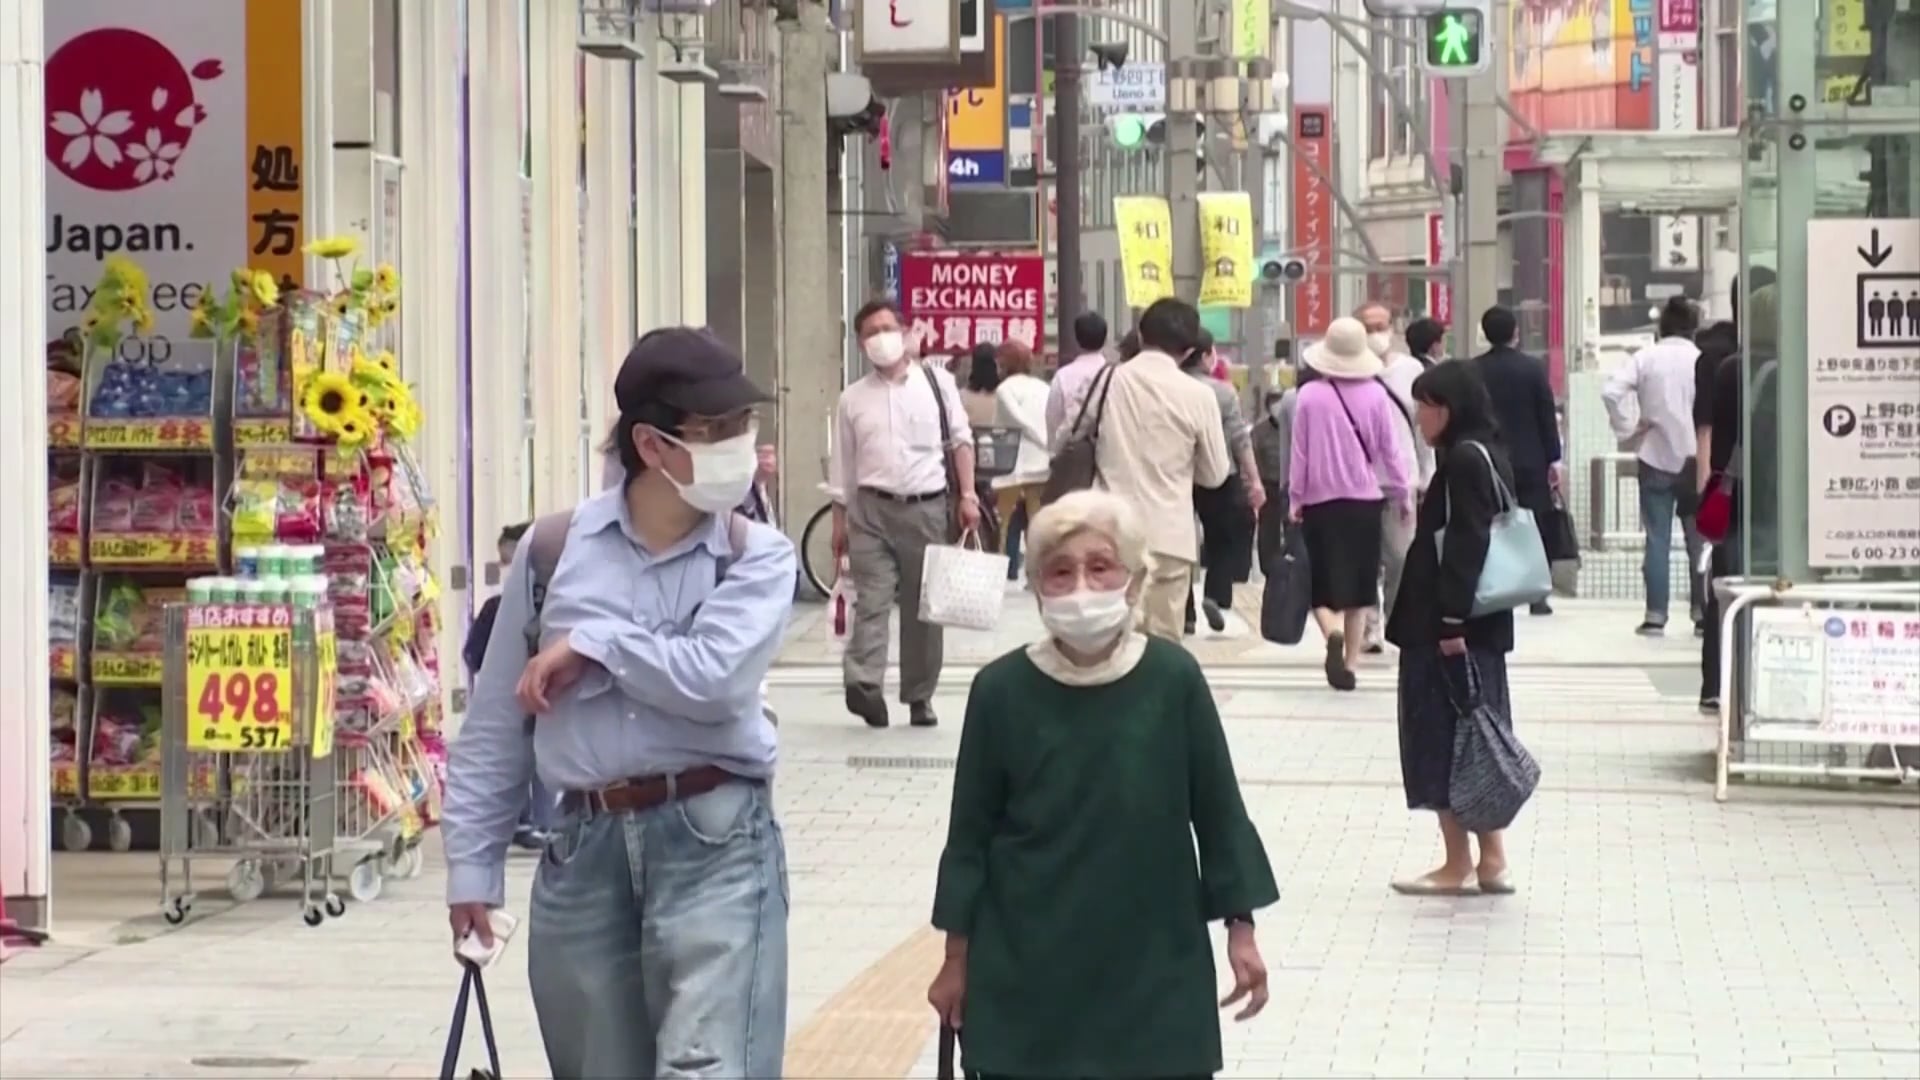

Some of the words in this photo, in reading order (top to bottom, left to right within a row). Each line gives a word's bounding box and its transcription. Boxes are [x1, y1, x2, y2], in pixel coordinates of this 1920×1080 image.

[1112, 88, 1144, 99] Ueno
[1149, 88, 1157, 98] 4
[47, 214, 194, 261] Japan.
[932, 264, 1018, 285] MONEY
[911, 288, 1038, 310] EXCHANGE
[1861, 402, 1919, 420] 上野中
[1861, 423, 1919, 438] 地下駐
[1825, 477, 1899, 491] 上野広小路
[187, 606, 290, 627] 当店おすすめ
[197, 671, 278, 723] 498
[239, 726, 280, 747] 537
